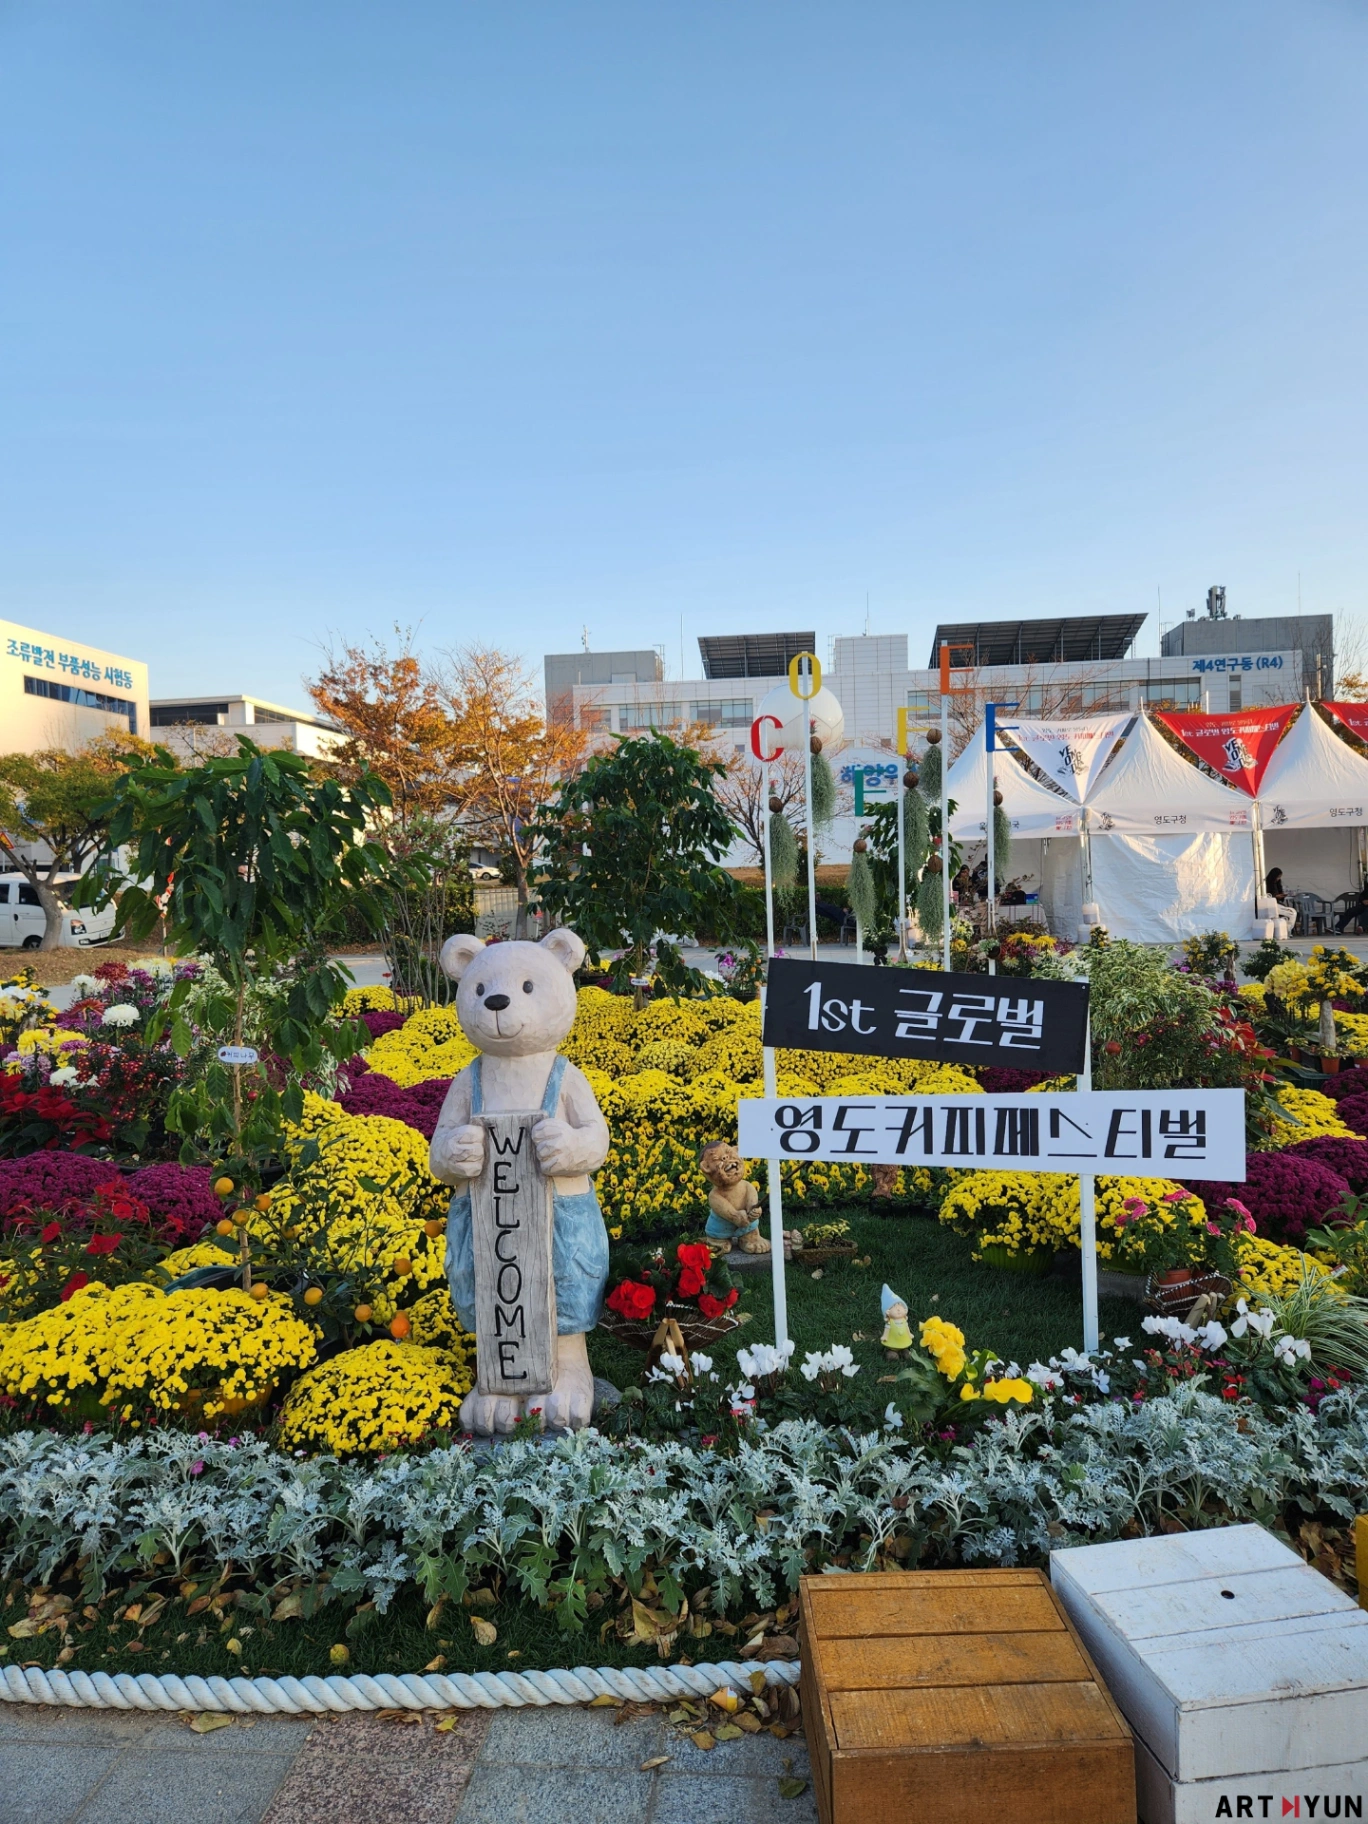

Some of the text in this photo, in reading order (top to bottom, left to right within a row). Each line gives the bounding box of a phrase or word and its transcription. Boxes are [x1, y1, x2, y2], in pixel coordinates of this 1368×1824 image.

[6, 638, 133, 690] 조류발전 부품성능 시험동
[1192, 655, 1283, 673] 제4연구동 (R4)
[1154, 814, 1187, 826] 영도구청
[1330, 806, 1363, 818] 영도구청
[803, 981, 1045, 1050] 1st 글로벌
[488, 1126, 528, 1380] WELCOME
